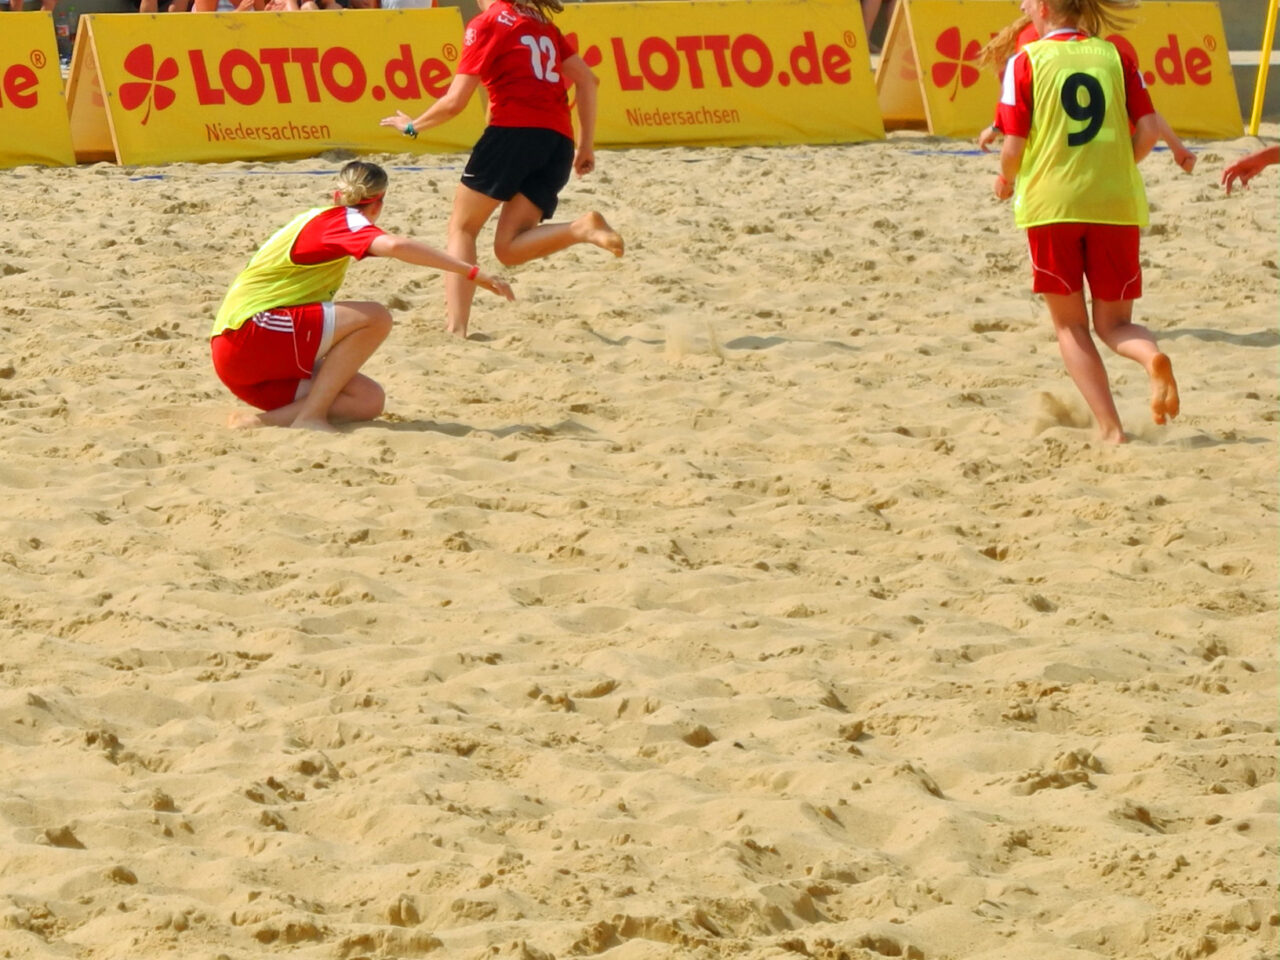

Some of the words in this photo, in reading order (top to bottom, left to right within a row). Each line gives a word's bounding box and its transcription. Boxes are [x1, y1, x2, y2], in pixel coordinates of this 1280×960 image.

[520, 35, 560, 83] 12
[625, 106, 741, 127] Niedersachsen
[1060, 72, 1106, 147] 9
[206, 120, 331, 142] Niedersachsen
